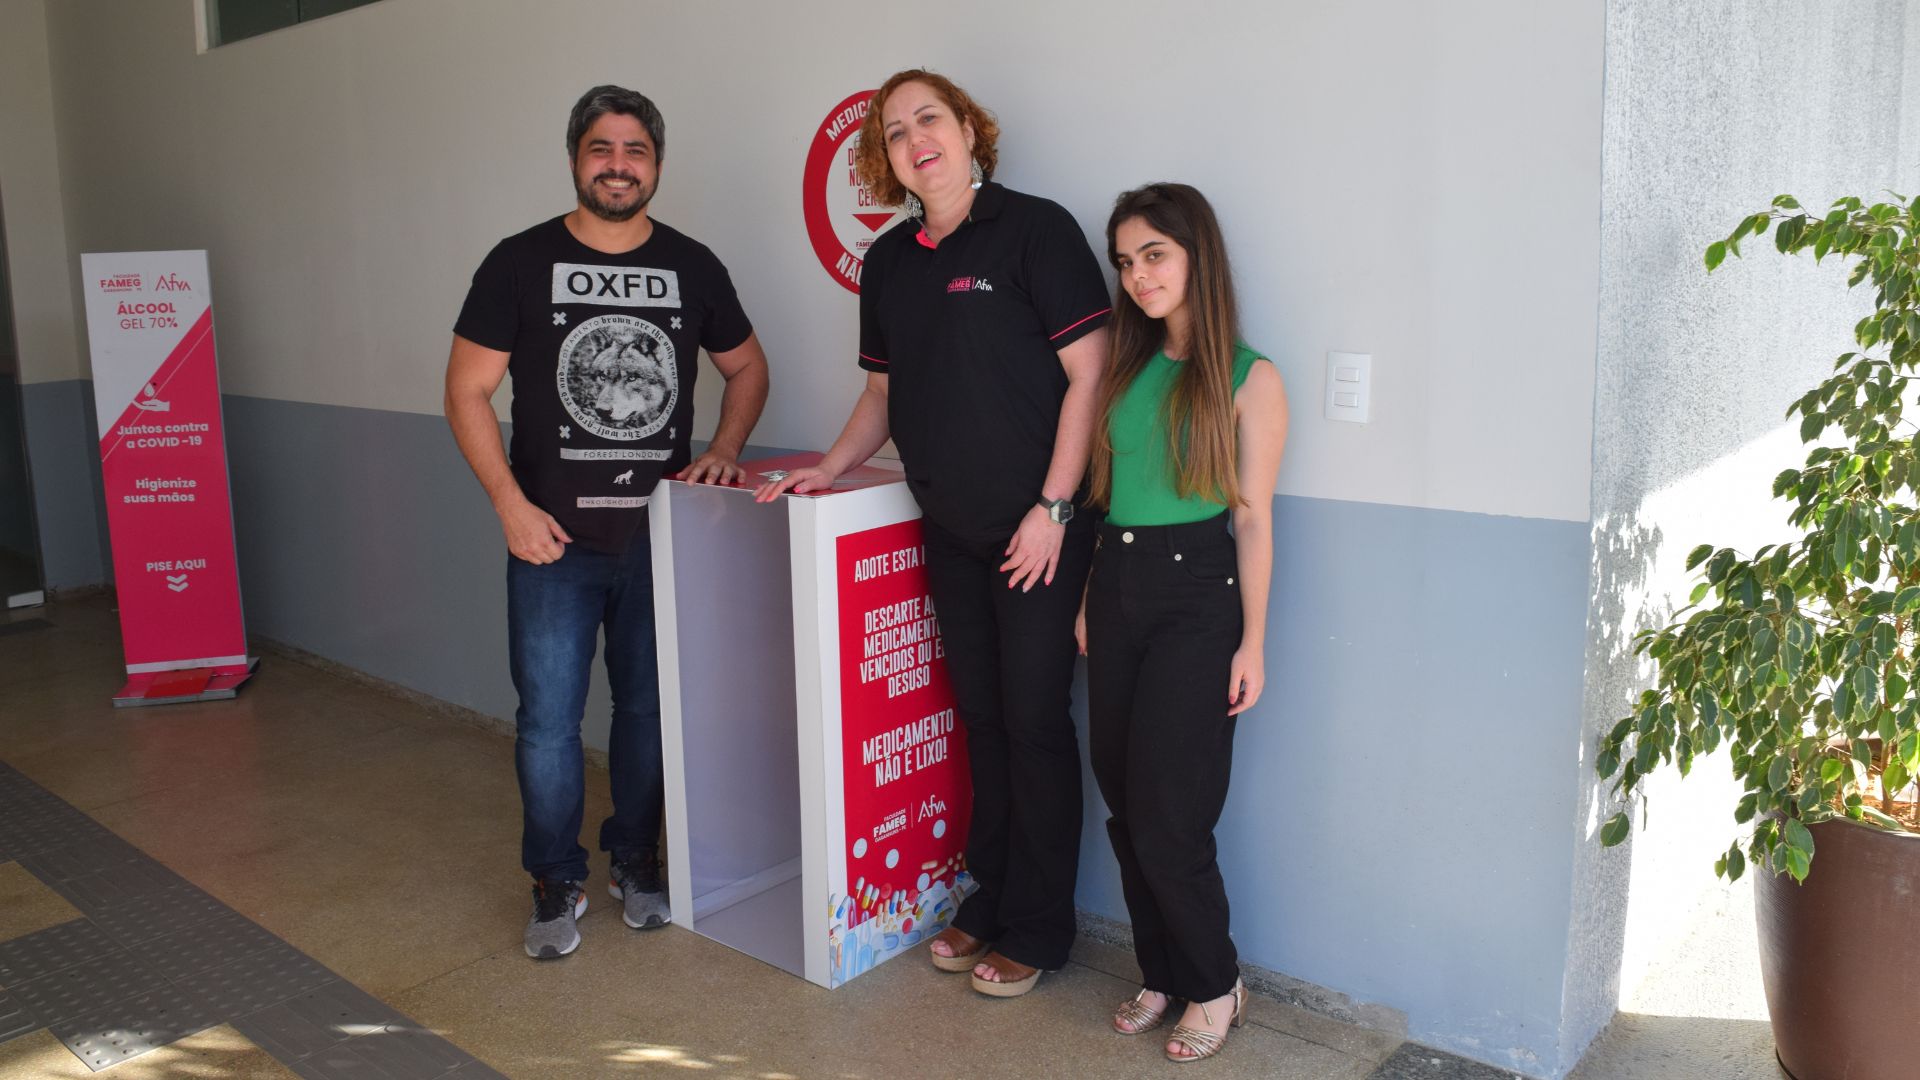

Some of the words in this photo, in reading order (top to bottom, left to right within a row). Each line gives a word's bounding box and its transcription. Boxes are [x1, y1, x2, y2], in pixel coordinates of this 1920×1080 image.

[826, 99, 872, 141] MEDIC
[858, 188, 877, 206] CER
[100, 279, 141, 288] FAMEG
[567, 271, 668, 299] OXFD
[117, 300, 176, 315] ÁLCOOL
[120, 318, 146, 330] GEL
[148, 316, 178, 329] 70%
[117, 424, 162, 436] Juntos
[164, 423, 209, 434] contra
[126, 440, 135, 449] a
[583, 451, 618, 459] FOREST
[622, 451, 661, 459] LONDON
[135, 477, 197, 492] Higienize
[123, 494, 156, 504] suas
[157, 492, 196, 503] mãos
[146, 560, 174, 572] PISE
[176, 558, 206, 571] AQUI
[854, 553, 889, 583] ADOTE
[892, 546, 919, 573] ESTA
[864, 597, 921, 634] DESCARTE
[859, 646, 915, 684] VENCIDOS
[917, 643, 932, 665] OU
[887, 664, 930, 699] DESUSO
[862, 708, 954, 766] MEDICAMENTO
[875, 753, 901, 788] NÃO
[904, 747, 913, 776] É
[916, 736, 948, 770] LIXO!
[873, 814, 907, 838] FAMEG
